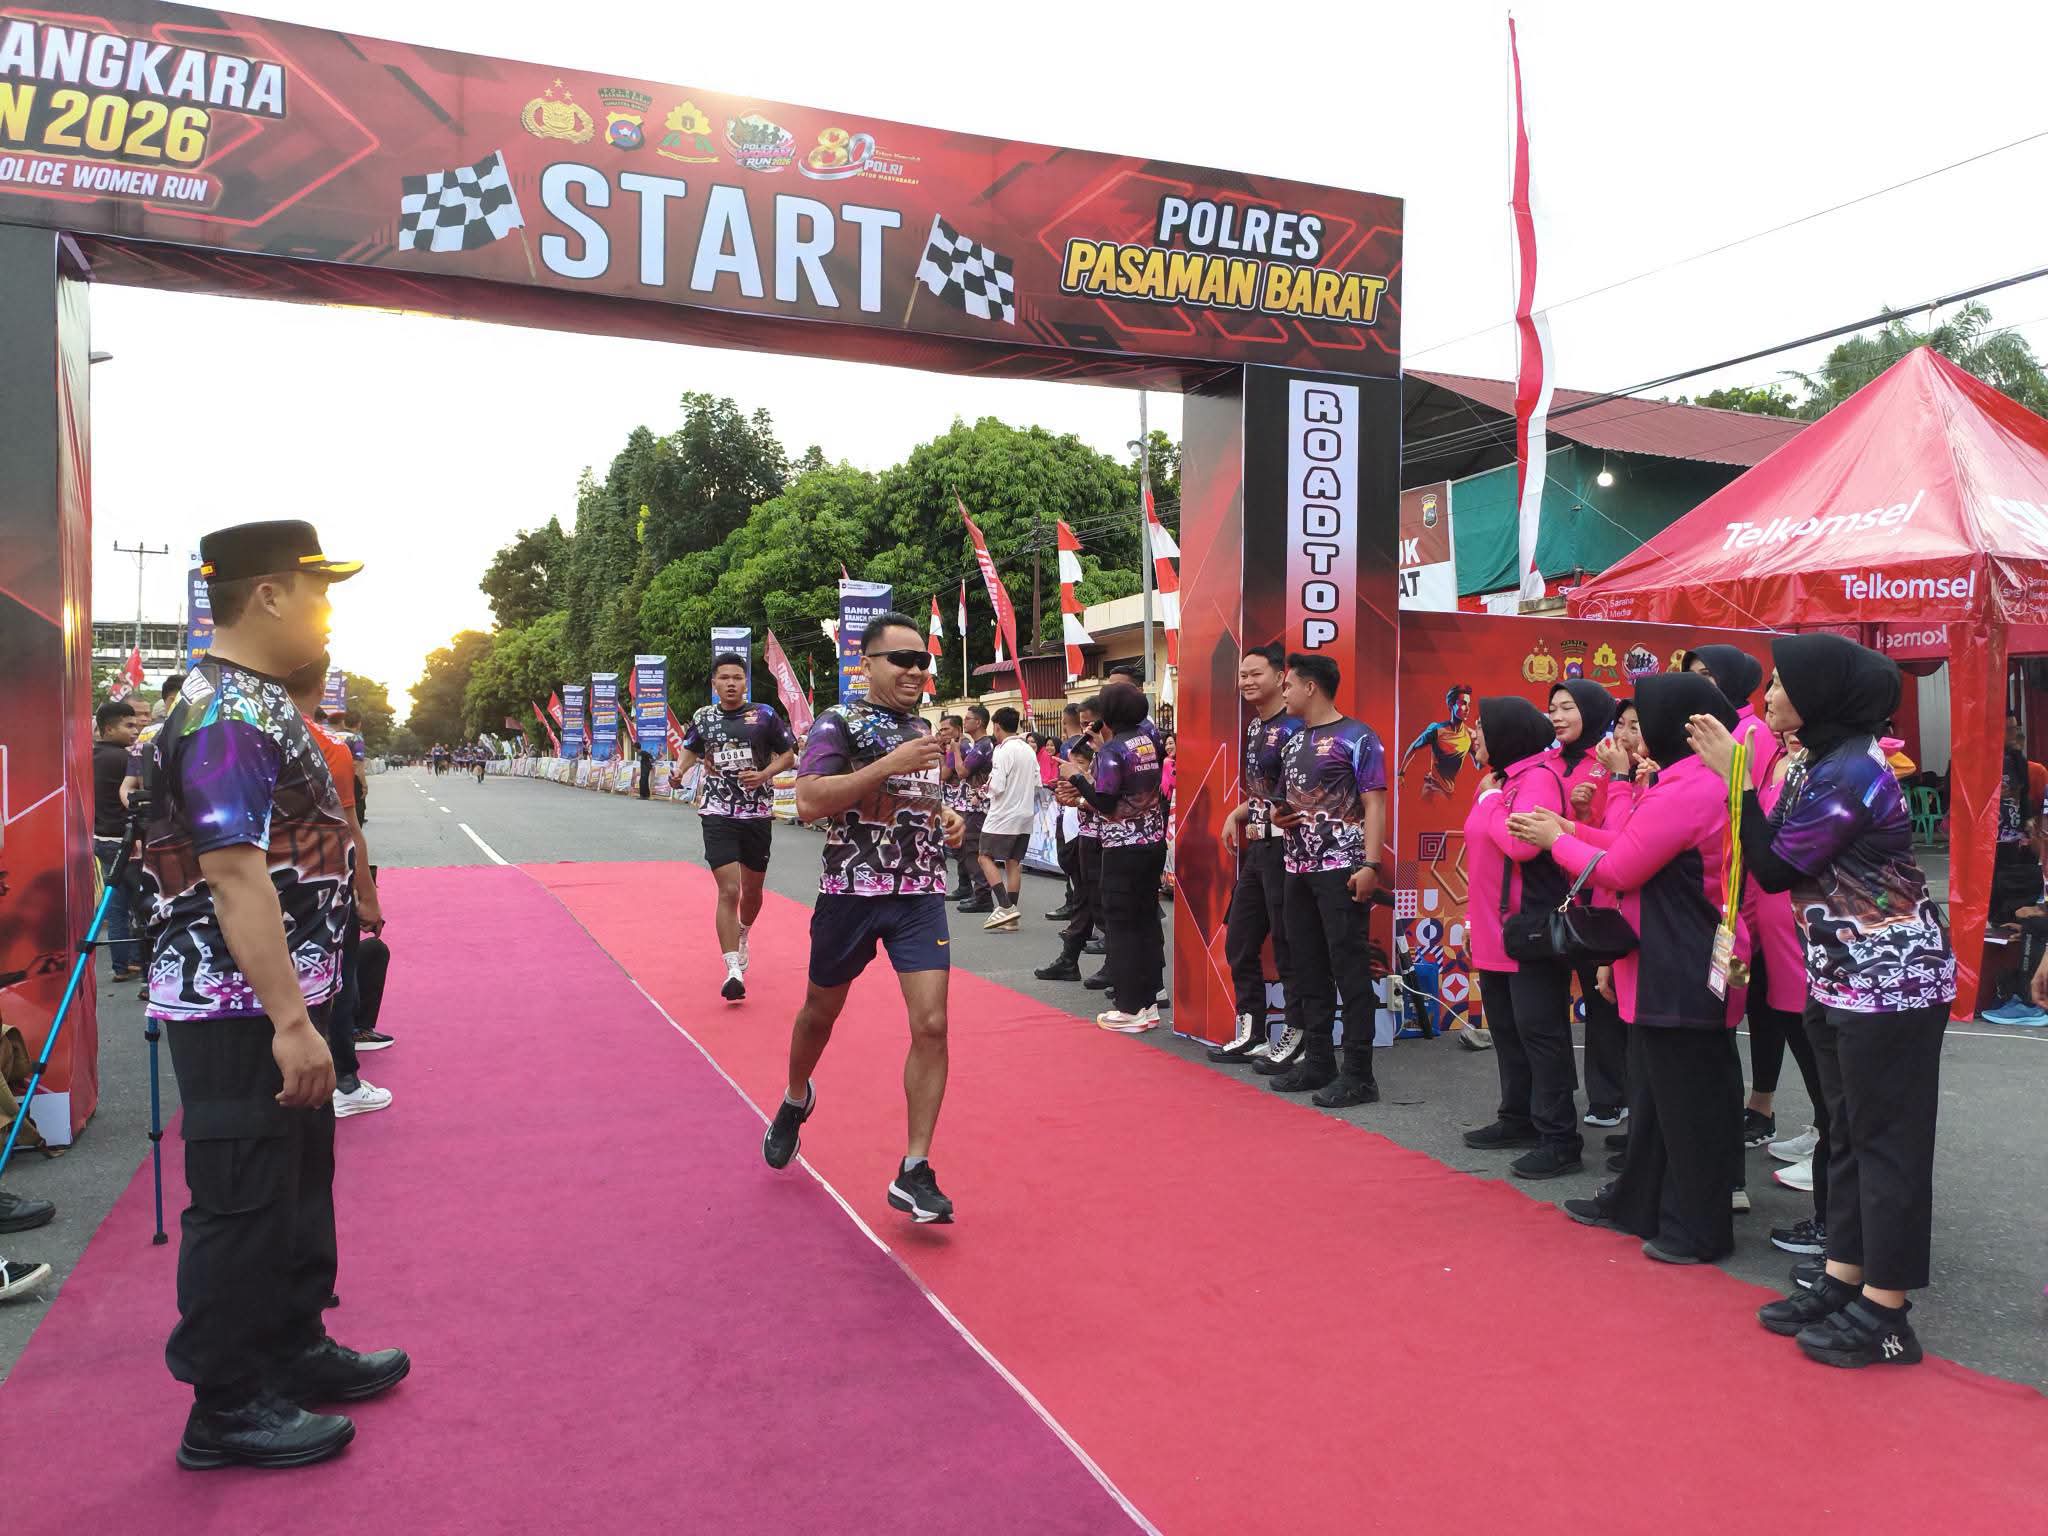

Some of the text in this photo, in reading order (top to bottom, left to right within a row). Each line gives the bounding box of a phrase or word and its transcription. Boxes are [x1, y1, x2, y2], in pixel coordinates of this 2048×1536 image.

[0, 21, 283, 115] ANGKARA
[44, 90, 209, 163] 2026
[0, 157, 207, 201] OLICE WOMEN RUN
[746, 157, 771, 168] RUN
[864, 159, 903, 176] POLRI
[540, 162, 901, 313] START
[1159, 197, 1321, 260] POLRES
[1066, 242, 1385, 321] PASAMAN BARAT
[1301, 389, 1343, 650] ROADTOP
[1722, 489, 1925, 551] Telkomsel
[844, 606, 870, 615] BANK
[1840, 569, 1976, 600] Telkomsel
[1610, 610, 1632, 619] Media
[720, 750, 745, 761] 0584
